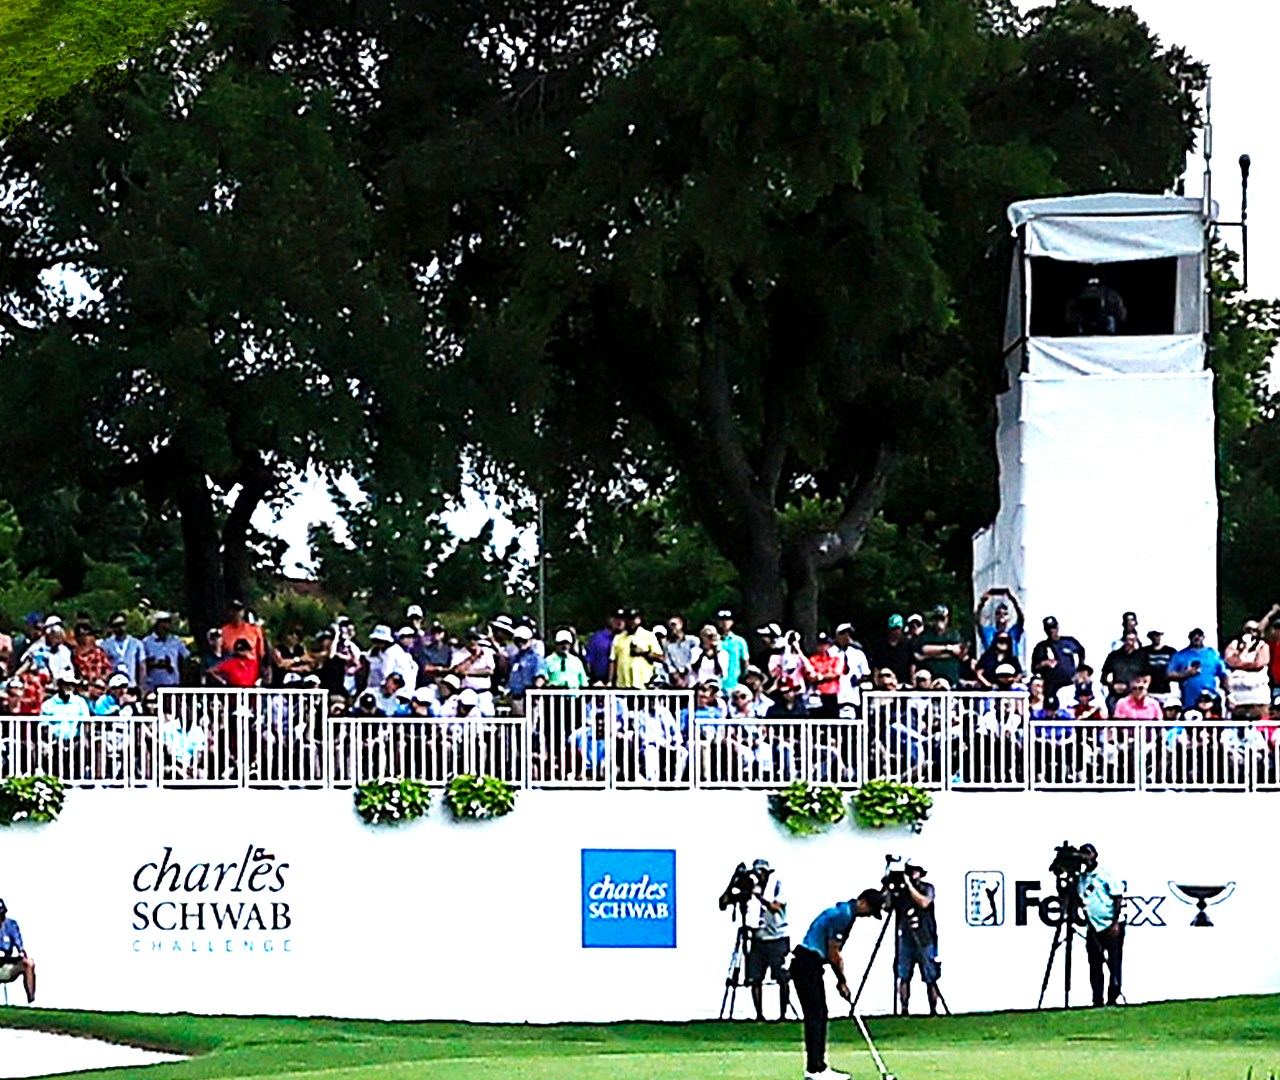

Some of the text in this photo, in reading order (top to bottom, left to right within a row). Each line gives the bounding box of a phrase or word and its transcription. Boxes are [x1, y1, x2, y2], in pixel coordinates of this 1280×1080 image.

[132, 844, 289, 892] charles
[589, 874, 668, 900] charles
[132, 901, 291, 930] SCHWAB
[589, 902, 668, 919] SCHWAB
[1015, 880, 1166, 927] Fex
[132, 939, 291, 952] CHALLENGE
